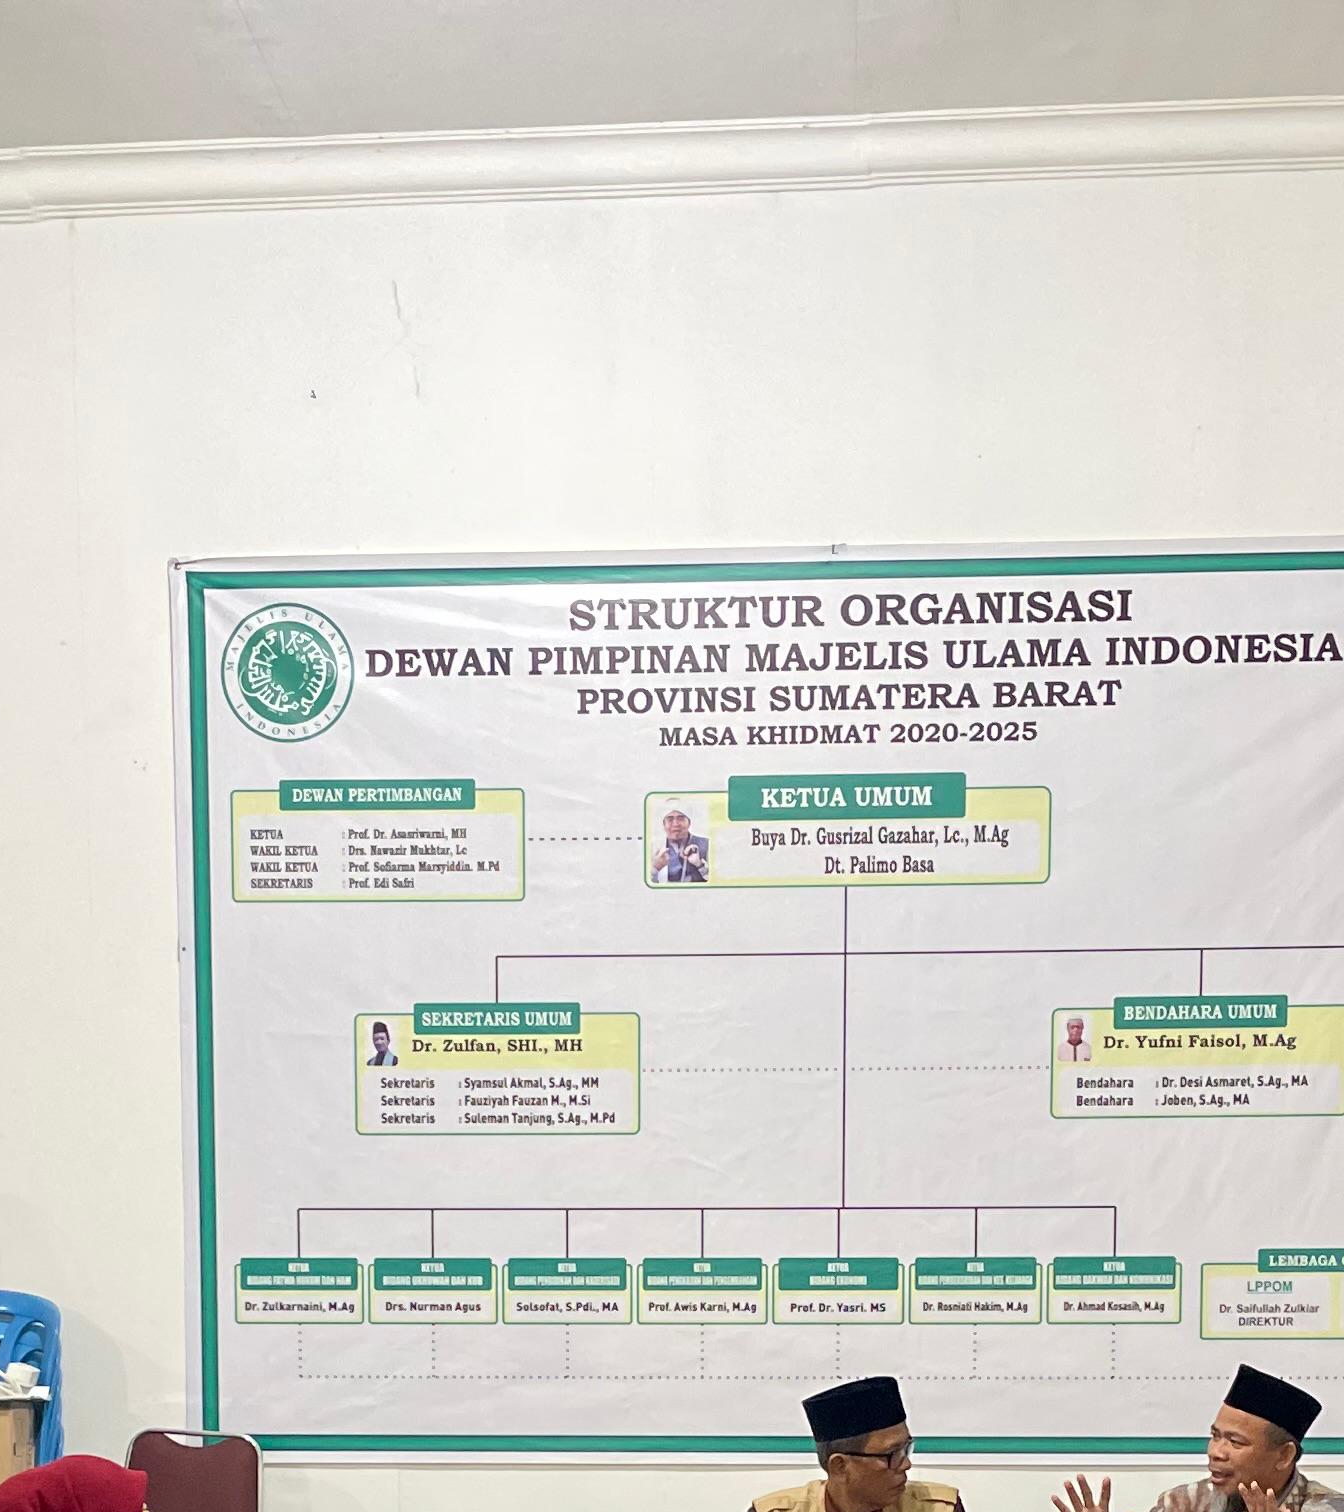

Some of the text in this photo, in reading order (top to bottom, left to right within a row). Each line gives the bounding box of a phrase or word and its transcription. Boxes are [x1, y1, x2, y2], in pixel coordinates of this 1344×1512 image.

[569, 589, 1133, 631] STRUKTUR ORGANISASI
[365, 633, 1344, 677] DEWAN PIMPINAN MAJELIS ULAMA INDONESIA
[577, 679, 1122, 715] PROVINSI SUMATERA BARAT
[236, 703, 342, 737] INDONESIA
[659, 721, 1038, 747] MASA KHIDMAT 2020-2025
[292, 786, 462, 803] DEWAN PERTIMBANGAN
[761, 786, 933, 809] KETUA UMUM
[250, 829, 283, 840] KETUA
[348, 829, 370, 840] Prof.
[373, 828, 388, 840] Dr.
[451, 828, 467, 839] MH
[751, 825, 1010, 851] Buya Dr. Gusrizal Gazahar, Lc., M.Ag
[250, 845, 319, 856] WAKIL KETUA
[348, 845, 367, 856] Drs.
[456, 845, 467, 856] Lc
[250, 861, 319, 873] WAKIL KETUA
[348, 861, 370, 873] Prof.
[477, 861, 500, 872] M.Pd
[824, 855, 935, 875] Dt. Palimo Basa
[250, 878, 313, 889] SEKRETARIS
[348, 878, 415, 889] Prof. Edi Safri
[1123, 1004, 1278, 1021] BENDAHARA UMUM
[421, 1011, 573, 1027] SEKRETARIS UMUM
[412, 1039, 583, 1054] Dr. Zulfan, SHI., MH
[1104, 1034, 1297, 1050] Dr. Yufni Faisol, M.Ag
[380, 1078, 435, 1089] Sekretaris
[464, 1077, 599, 1091] Syamsul Akmal, S.Ag., MM
[1076, 1077, 1134, 1089] Bendahara
[1162, 1075, 1309, 1089] Dr. Desi Asmaret, S.Ag., MA
[381, 1095, 435, 1107] Sekretaris
[464, 1095, 510, 1109] Fauziyah
[512, 1095, 548, 1107] Fauzan
[569, 1095, 591, 1107] M.Si
[1076, 1095, 1134, 1107] Bendahara
[1161, 1094, 1250, 1108] Joben, S.Ag., MA
[381, 1113, 436, 1124] Sekretaris
[464, 1112, 616, 1127] Suleman Tanjung, S.Ag., M.Pd
[1269, 1255, 1338, 1267] LEMBAGA
[1247, 1281, 1292, 1293] LPPOM
[244, 1301, 355, 1314] Dr. Zulkarnaini, M.Ag
[385, 1302, 482, 1314] Drs. Nurman Agus
[516, 1302, 563, 1313] Solsofat,
[602, 1302, 619, 1312] MA
[648, 1302, 757, 1314] Prof. Awis Karni, M.Ag
[790, 1303, 816, 1313] Prof.
[818, 1303, 835, 1313] Dr.
[870, 1303, 886, 1313] MS
[923, 1301, 1028, 1313] Dr. Rosniati Hakim, M.Ag
[1063, 1302, 1165, 1313] Dr. Ahmad Kosasih, M.Ag
[1219, 1304, 1234, 1314] Dr.
[1238, 1317, 1294, 1327] DIREKTUR
